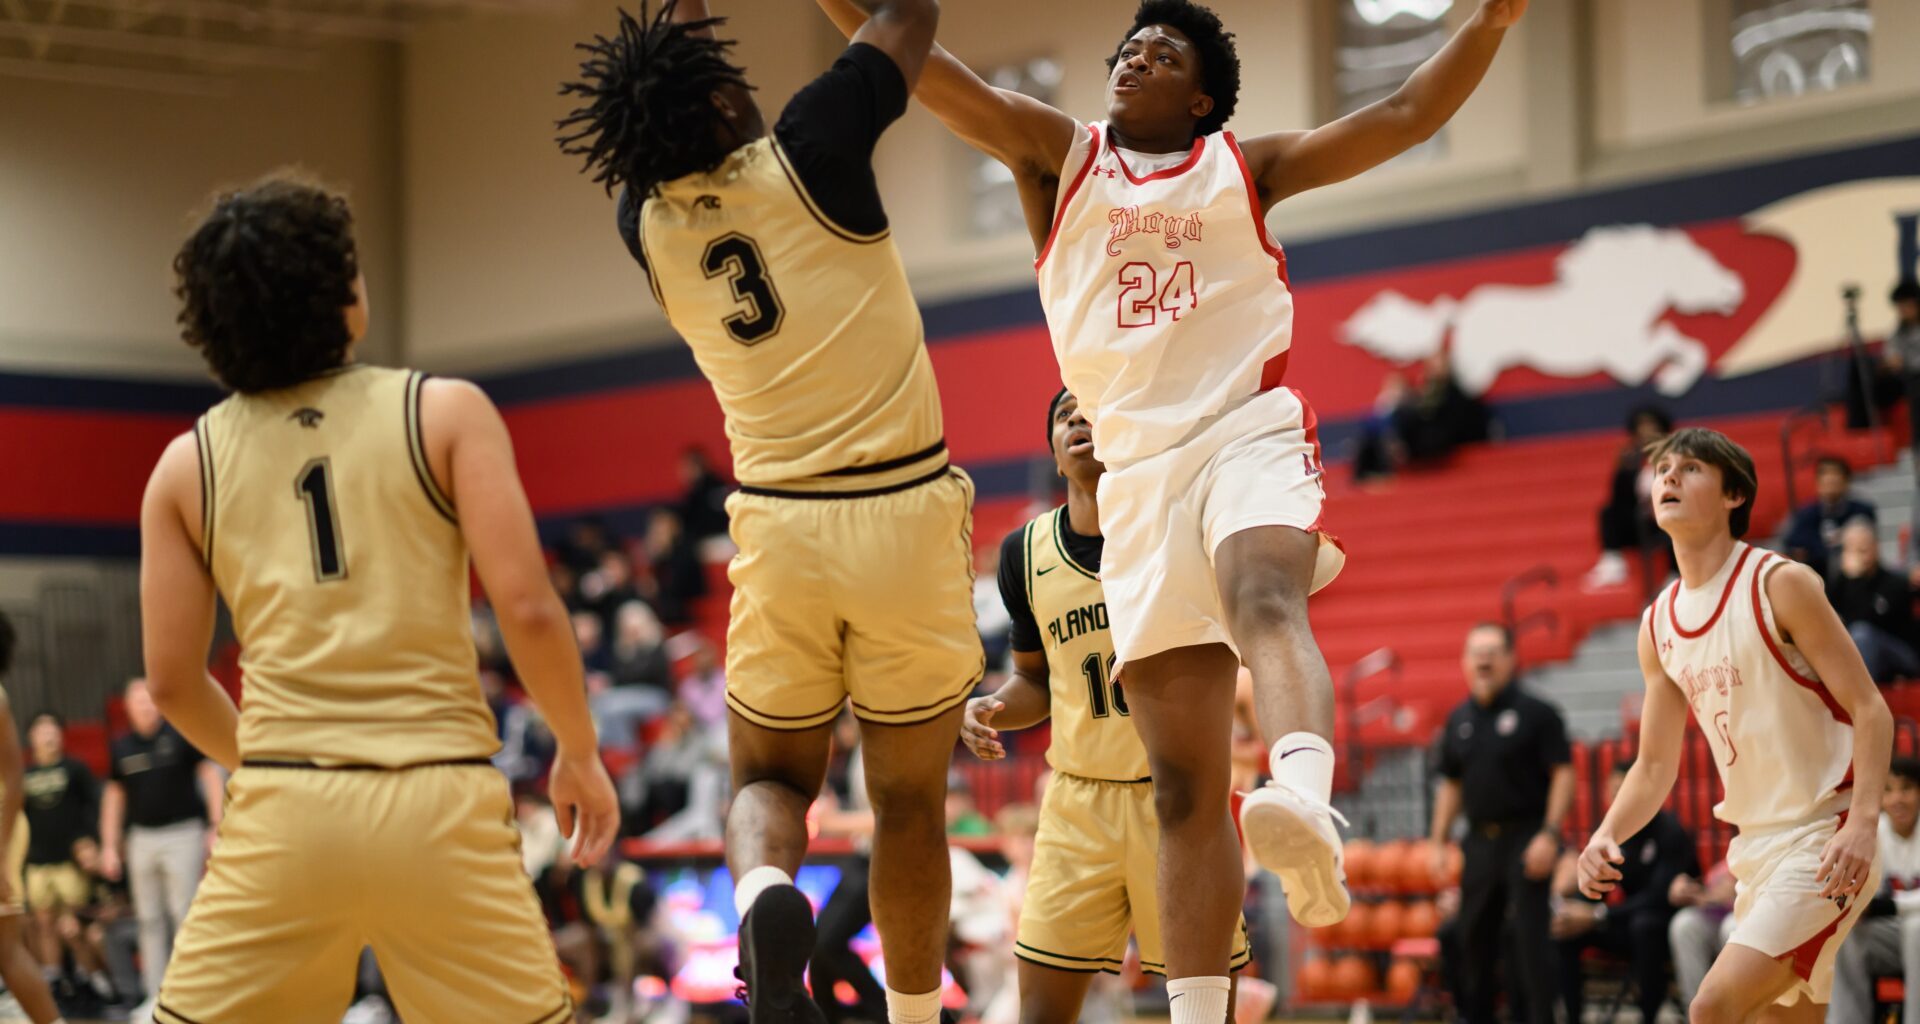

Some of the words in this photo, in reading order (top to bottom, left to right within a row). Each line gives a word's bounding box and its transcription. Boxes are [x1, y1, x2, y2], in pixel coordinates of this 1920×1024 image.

[1107, 205, 1202, 256] Boyd
[700, 229, 786, 347] 3
[1117, 261, 1197, 328] 24
[293, 455, 349, 583] 1
[1048, 602, 1110, 649] PLANO
